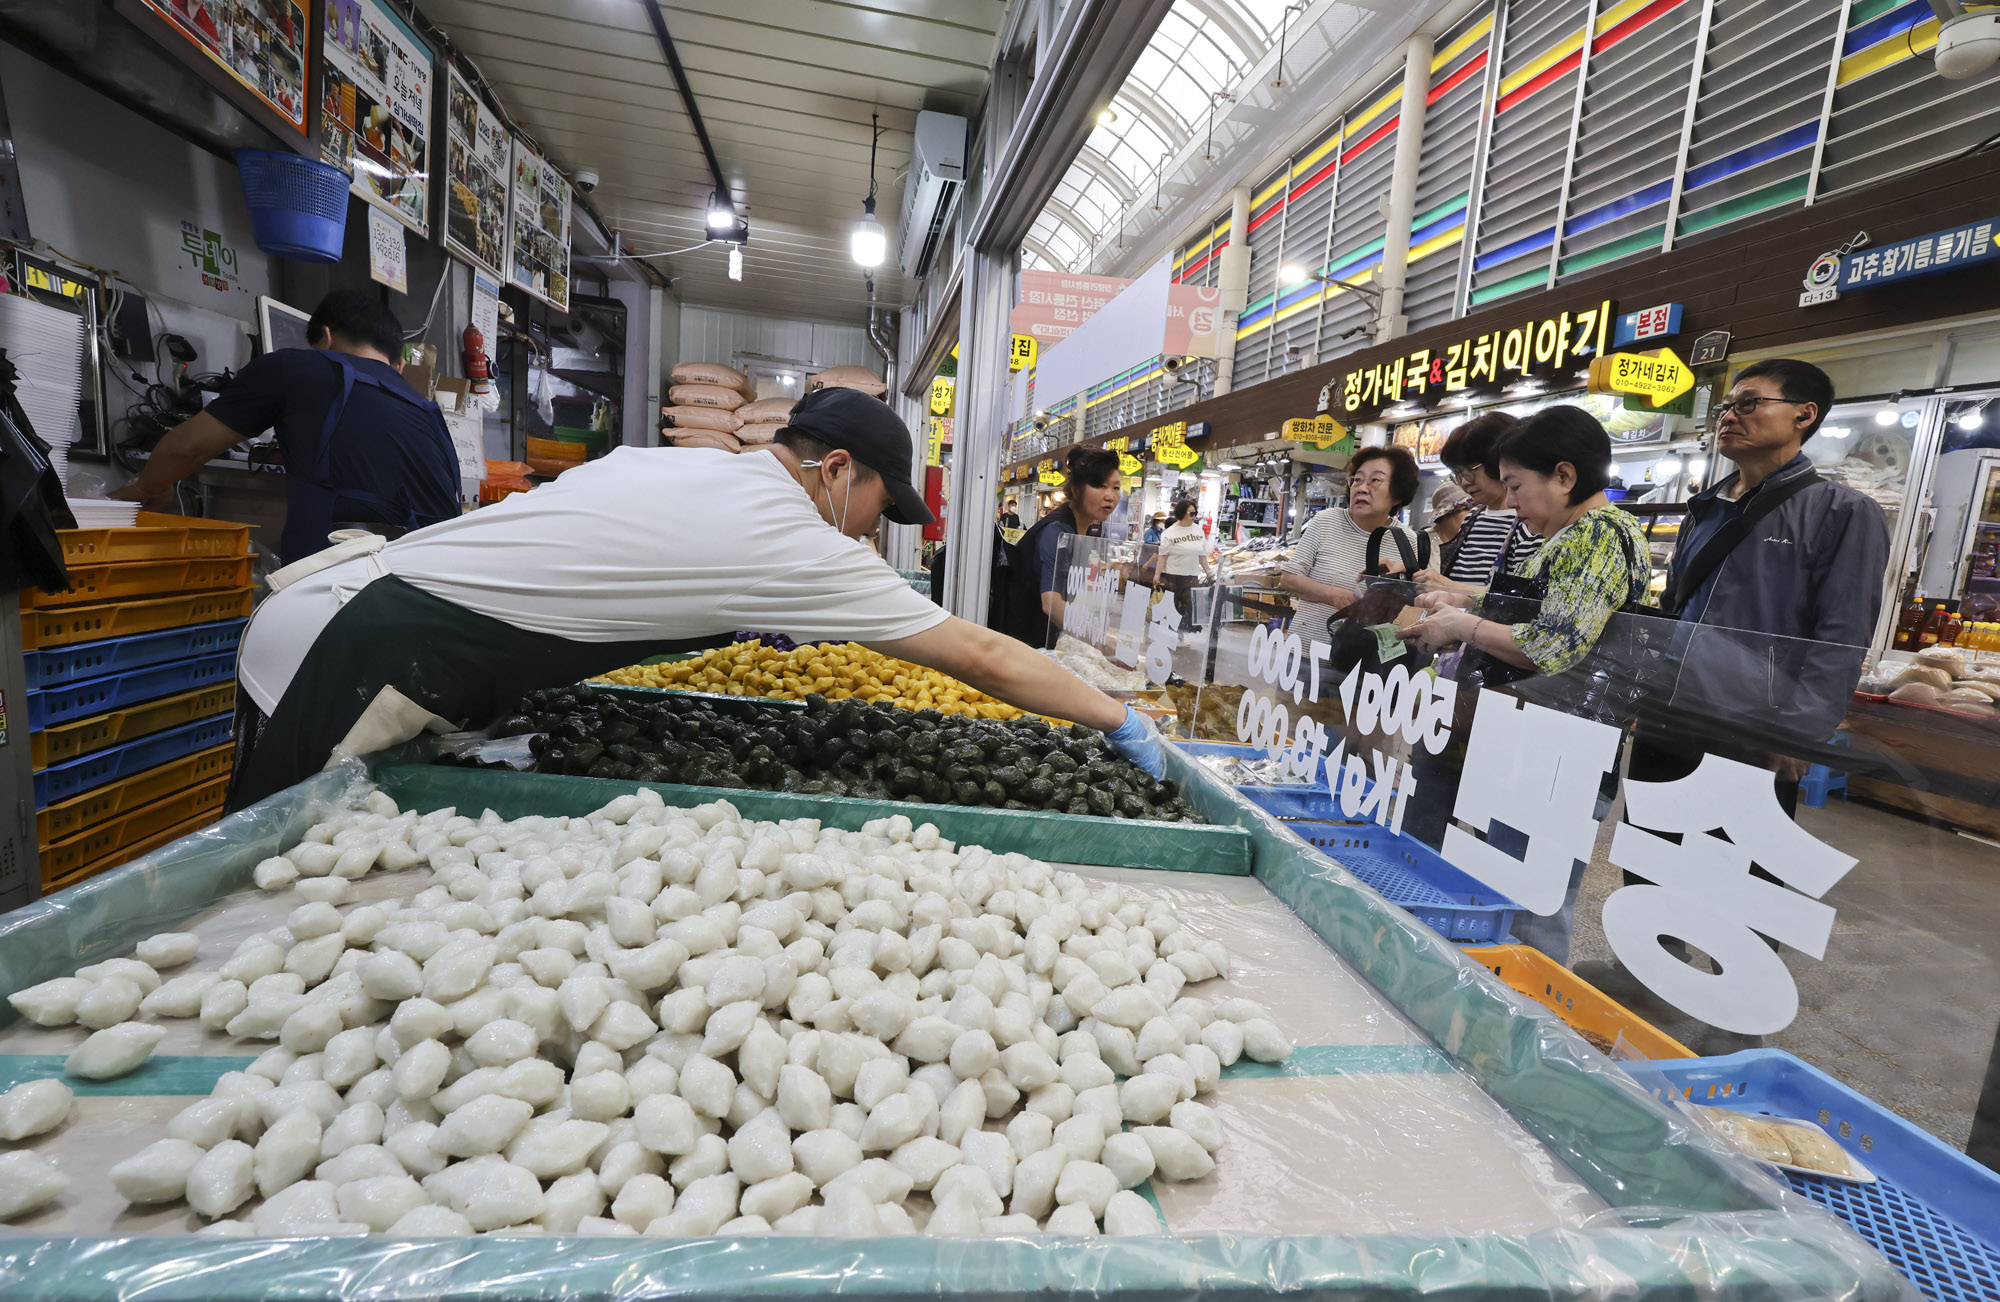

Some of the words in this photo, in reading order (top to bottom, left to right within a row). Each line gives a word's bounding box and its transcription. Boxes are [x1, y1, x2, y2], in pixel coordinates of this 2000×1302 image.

[181, 229, 239, 276] 투데이
[1803, 290, 1834, 304] 다-13
[1637, 306, 1668, 337] 본점
[1700, 346, 1716, 361] 21
[1618, 358, 1680, 385] 정가네김치
[1615, 378, 1677, 394] 010-4922-3062
[1292, 421, 1315, 433] 쌍화차
[1317, 422, 1333, 434] 전문
